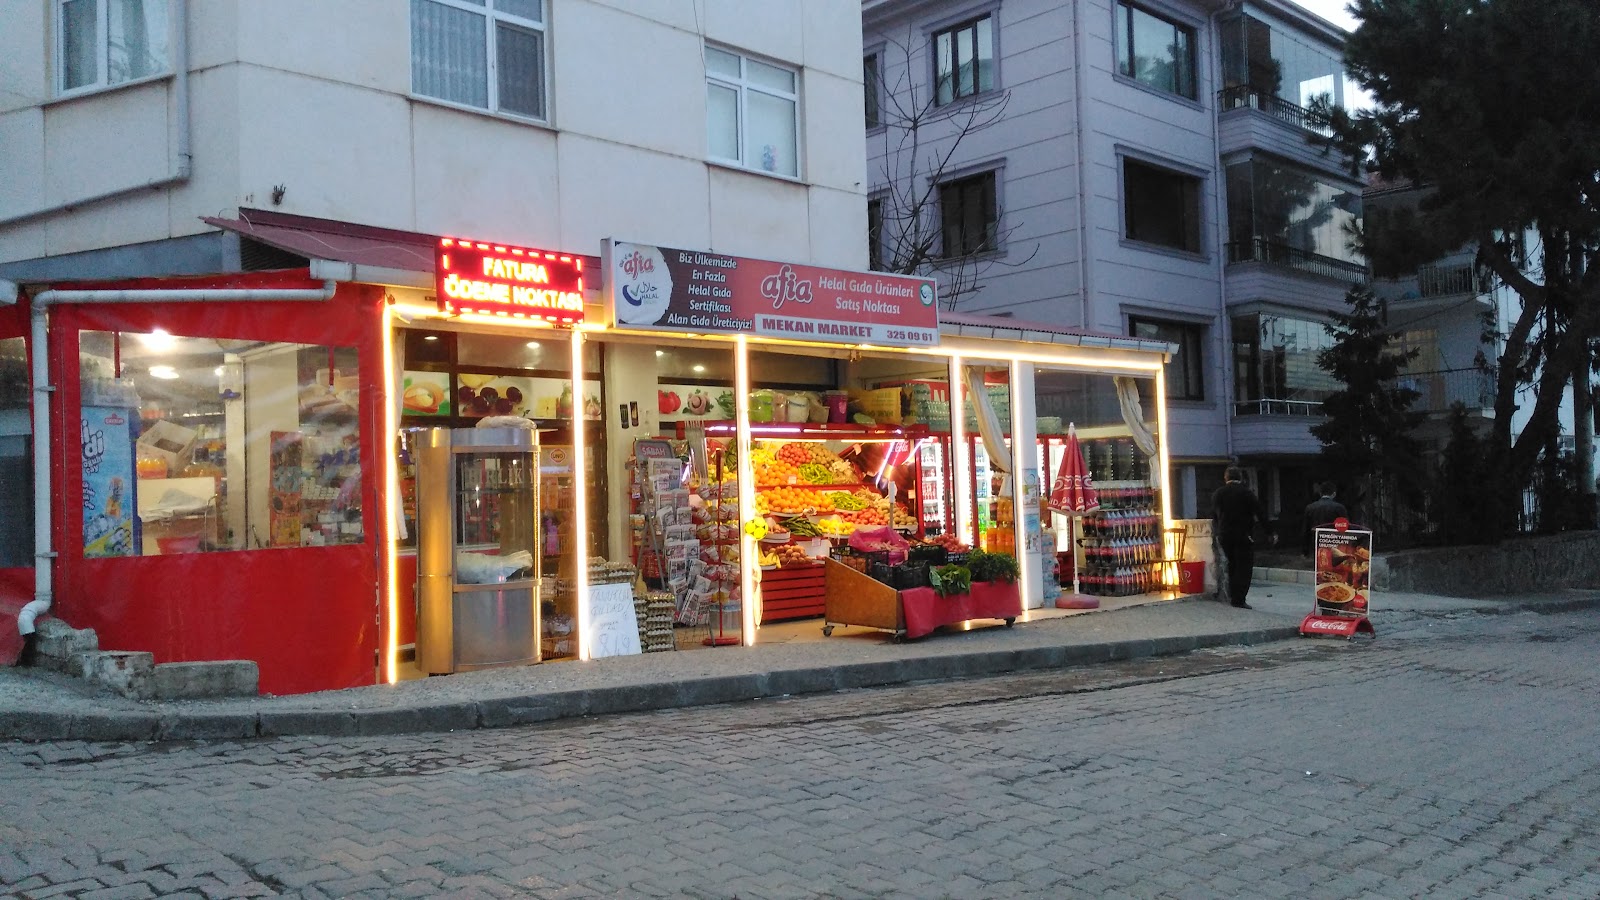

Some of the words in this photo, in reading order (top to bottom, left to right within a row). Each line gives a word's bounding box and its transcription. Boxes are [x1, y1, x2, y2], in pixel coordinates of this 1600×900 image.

[623, 251, 653, 280] afia
[679, 252, 692, 263] Biz
[695, 252, 737, 269] Ülkemizde
[483, 257, 548, 284] FATURA
[692, 270, 702, 280] En
[705, 271, 726, 282] Fazla
[444, 273, 510, 303] ÖDEME
[513, 285, 583, 312] NOKTASI
[688, 284, 710, 296] Helal
[713, 286, 731, 298] Gıda
[761, 264, 813, 309] afia
[818, 276, 847, 291] Helal
[850, 280, 872, 294] Gıda
[875, 280, 914, 298] Ürünleri
[690, 300, 731, 313] Sertifikası
[836, 297, 860, 314] Satış
[863, 299, 900, 314] Noktası
[667, 313, 688, 324] Alan
[691, 315, 709, 326] Gıda
[712, 314, 752, 331] Üreticiyiz!
[762, 318, 814, 334] MEKAN
[818, 323, 873, 338] MARKET
[887, 330, 906, 340] 325
[907, 331, 920, 341] 09
[921, 332, 933, 342] 61
[1312, 621, 1348, 631] Coca-Cola
